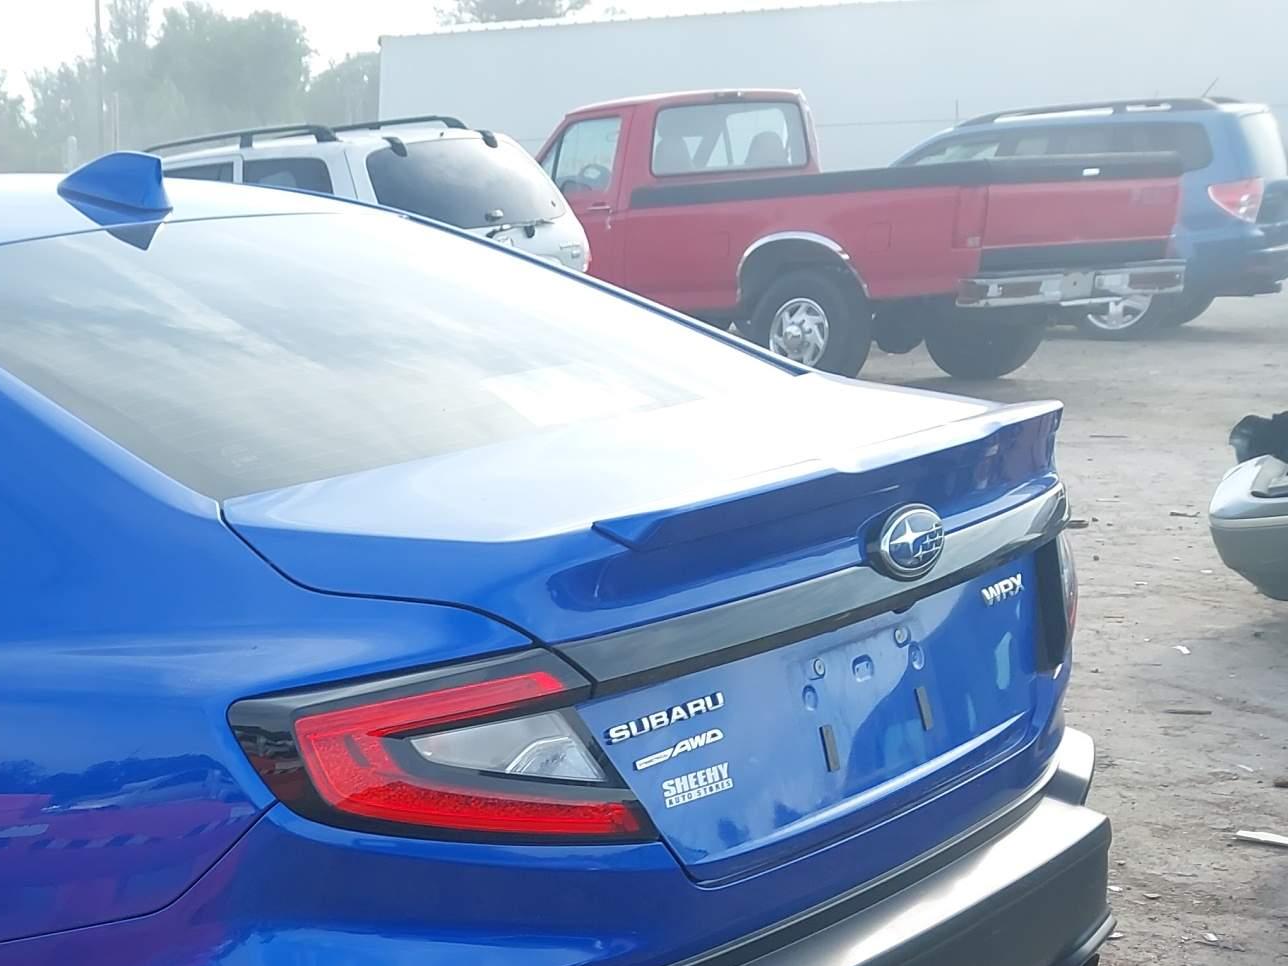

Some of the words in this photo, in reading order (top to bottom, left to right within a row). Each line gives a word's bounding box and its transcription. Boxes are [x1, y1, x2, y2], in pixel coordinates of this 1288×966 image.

[981, 572, 1024, 605] WRX
[604, 691, 725, 745] SUBARU
[671, 728, 724, 757] AWD
[662, 762, 729, 797] SHEEHY
[668, 793, 693, 806] AUTO
[696, 780, 732, 797] STORES
